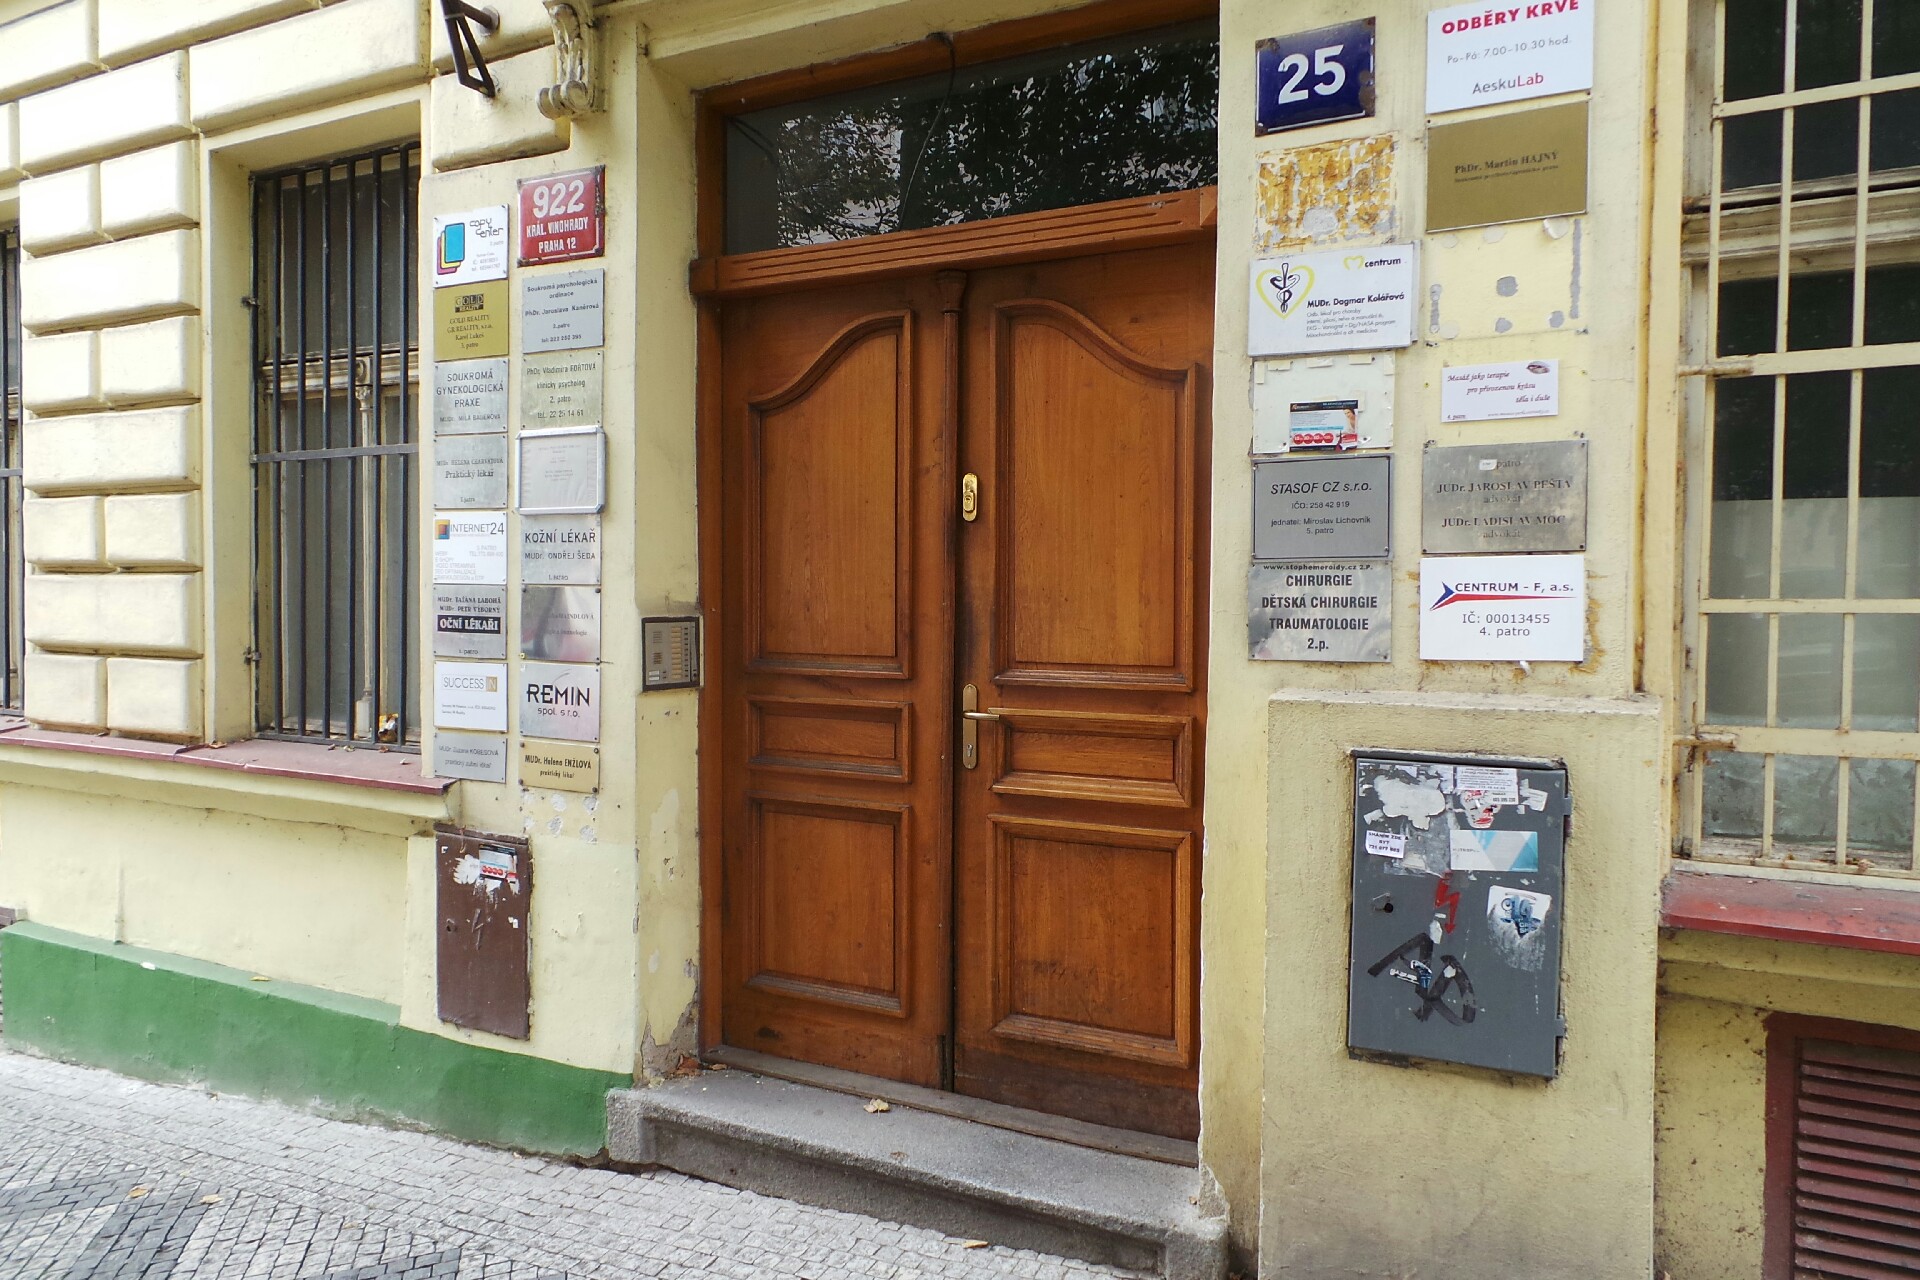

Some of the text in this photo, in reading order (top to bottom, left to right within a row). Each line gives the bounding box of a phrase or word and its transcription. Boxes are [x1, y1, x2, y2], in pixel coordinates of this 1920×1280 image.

[1442, 0, 1579, 34] ODBĚRY KRVE
[1549, 35, 1572, 46] hod.
[1278, 44, 1346, 104] 25
[1472, 72, 1544, 94] AeskuLab
[1454, 164, 1482, 174] PhDr.
[1485, 158, 1518, 168] Martin
[533, 180, 584, 218] 922
[470, 218, 492, 230] copy
[526, 216, 588, 238] KRÁL. VINOHRADY
[476, 228, 504, 238] center
[538, 237, 576, 253] PRAHA 12
[1365, 258, 1401, 268] centrum
[527, 277, 598, 292] Soukromá psychologická
[455, 294, 484, 305] GOLD
[1307, 292, 1404, 308] MUDr. Dagmar Kolářová
[448, 368, 493, 382] SOUKROMÁ
[1470, 372, 1485, 382] jako
[1487, 371, 1510, 380] terapie
[436, 380, 504, 395] GYNEKOLOGICKÁ
[558, 379, 585, 389] psycholog
[1467, 387, 1477, 395] pro
[1479, 385, 1515, 394] přirozenou
[455, 398, 480, 407] PRAXE
[558, 395, 571, 404] patro
[1535, 393, 1550, 402] duše
[1496, 460, 1521, 469] patro
[445, 468, 494, 479] Praktický lékař
[1271, 482, 1372, 494] STASOF CZ s.r.o.
[1437, 478, 1571, 493] JUDr. JAROSLAV PEŠTA
[1292, 500, 1308, 509] IČO:
[1484, 495, 1521, 504] advokát
[1271, 519, 1301, 527] jednatel:
[1442, 515, 1566, 528] JUDr. LADISLAV MOC
[525, 528, 596, 543] KOŽNÍ LÉKAŘ
[1483, 530, 1521, 538] advokát
[548, 550, 574, 559] ONDŘEJ
[577, 550, 596, 559] ŠEDA
[1286, 575, 1352, 586] CHIRURGIE
[1455, 583, 1518, 592] CENTRUM
[1534, 583, 1545, 593] F,
[1262, 594, 1378, 608] DĚTSKÁ CHIRURGIE
[440, 617, 499, 630] OČNÍ LÉKAŘI
[1462, 611, 1550, 624] IČ: 00013455
[1270, 618, 1369, 630] TRAUMATOLOGIE
[1480, 627, 1530, 638] 4. patro
[1308, 638, 1329, 651] 2.p.
[444, 677, 484, 689] SUCCESS
[526, 684, 590, 707] REMIN
[538, 708, 557, 716] spol.
[525, 755, 591, 769] MUDr. Helena ENŽLOVÁ
[540, 770, 560, 778] praktický
